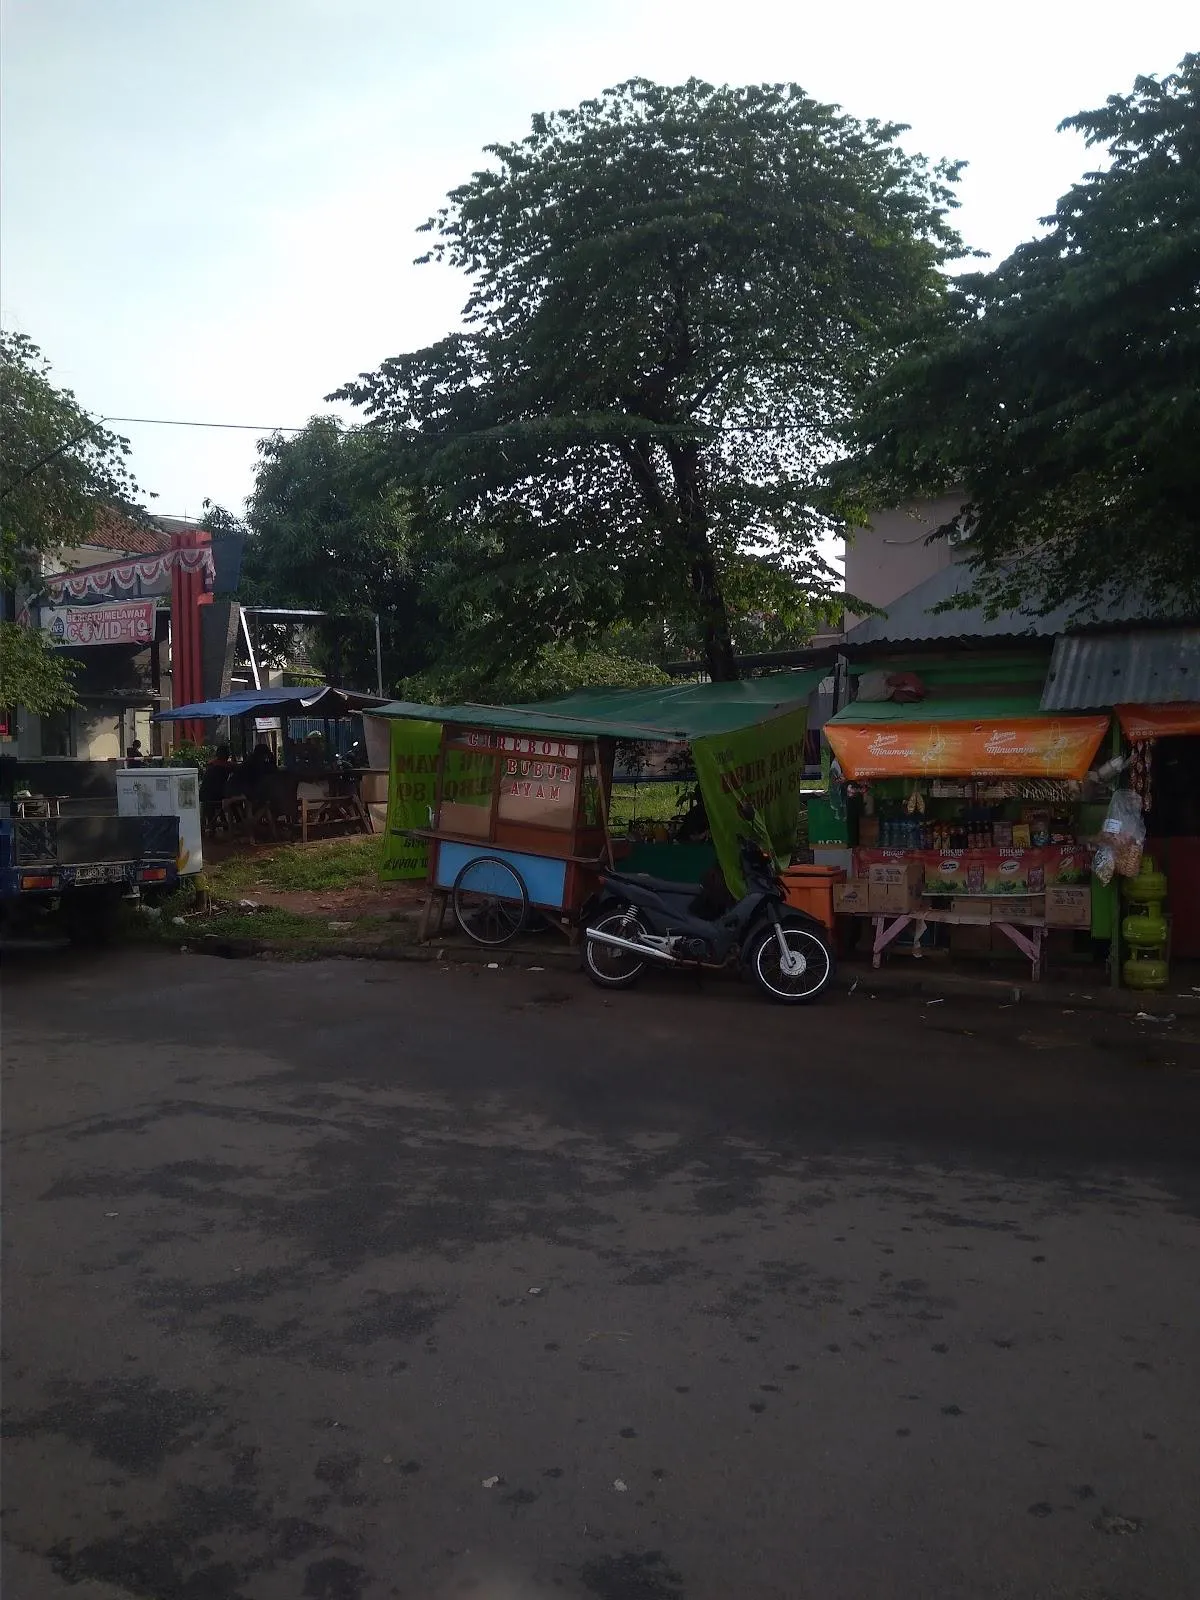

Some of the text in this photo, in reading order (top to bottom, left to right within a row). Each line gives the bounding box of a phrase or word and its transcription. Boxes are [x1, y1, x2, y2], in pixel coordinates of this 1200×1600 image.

[67, 609, 146, 623] BERSATU MELAWAN
[67, 619, 149, 643] COVID-19
[507, 759, 571, 782] BUBUR
[510, 782, 560, 801] AYAM
